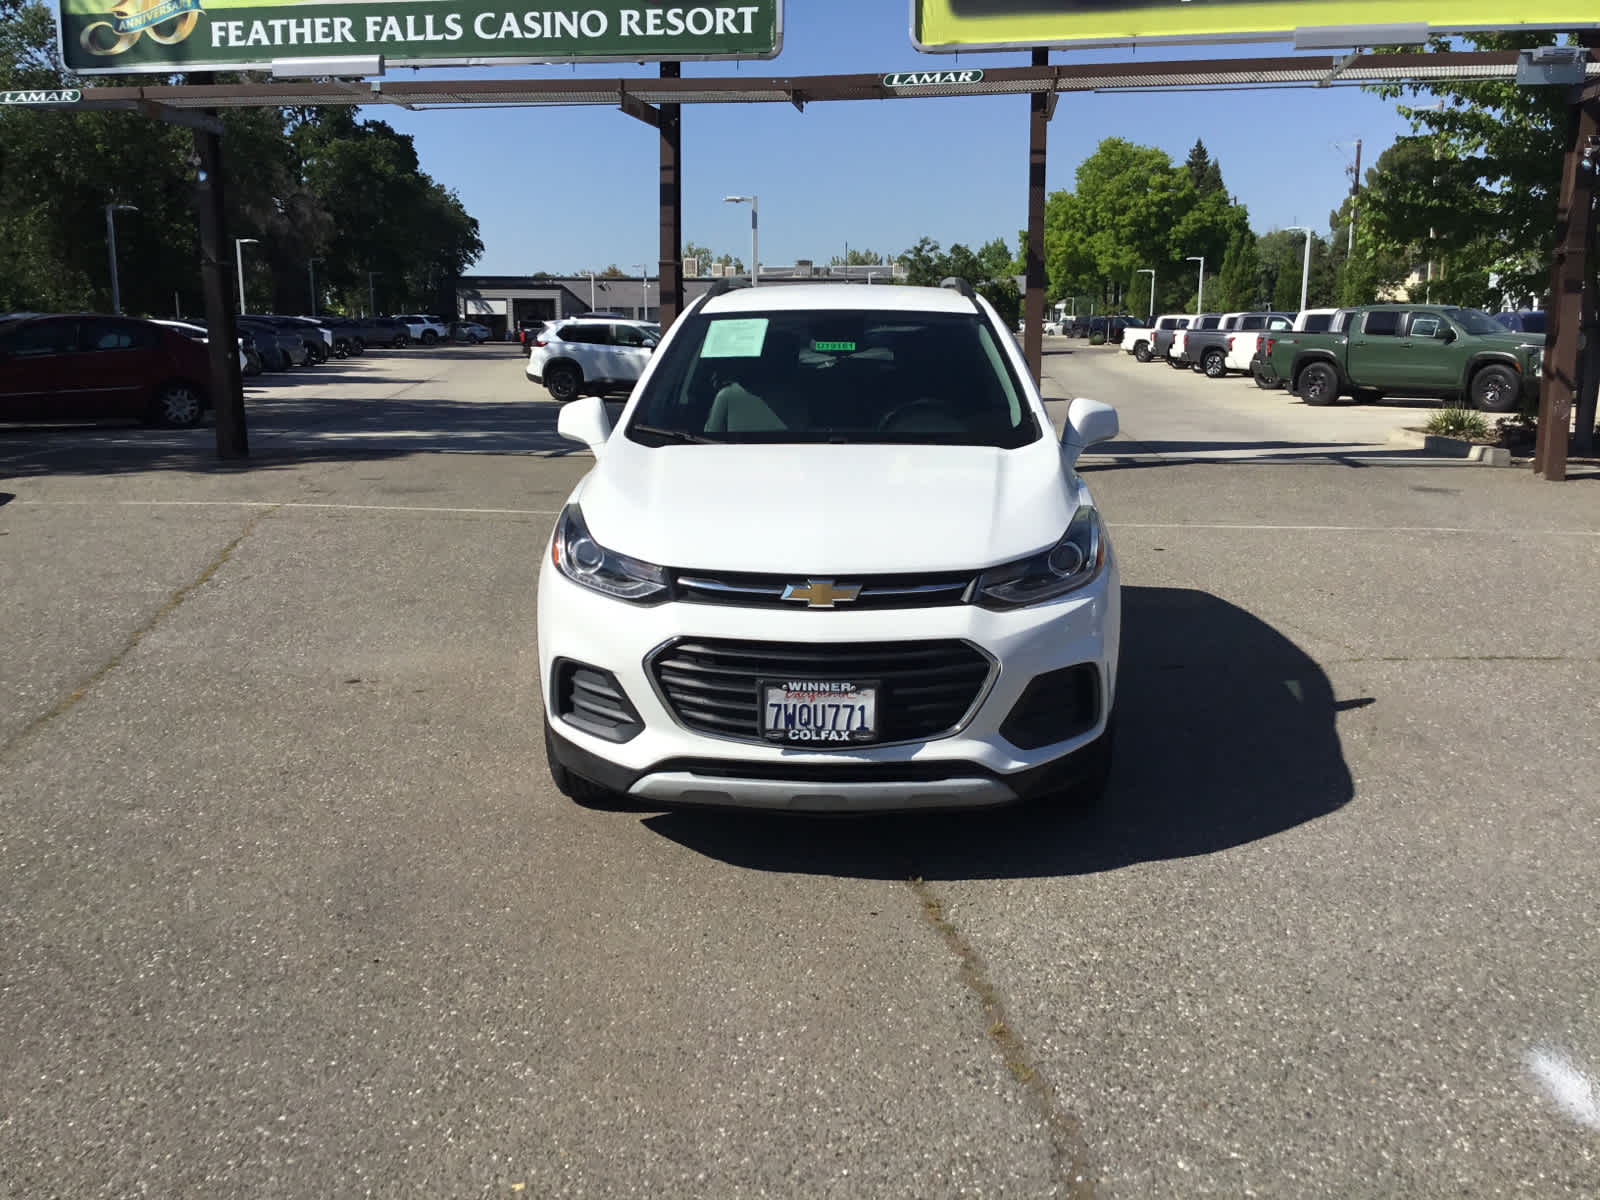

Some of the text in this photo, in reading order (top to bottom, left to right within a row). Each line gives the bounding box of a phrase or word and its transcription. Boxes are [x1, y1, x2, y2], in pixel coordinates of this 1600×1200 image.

[210, 6, 759, 48] FEATHER FALLS CASINO RESORT
[891, 71, 973, 86] LAMAR
[4, 91, 73, 103] LAMAR
[788, 682, 851, 692] WINNER
[769, 703, 869, 731] 7WQU771
[788, 730, 850, 740] COLFAX
